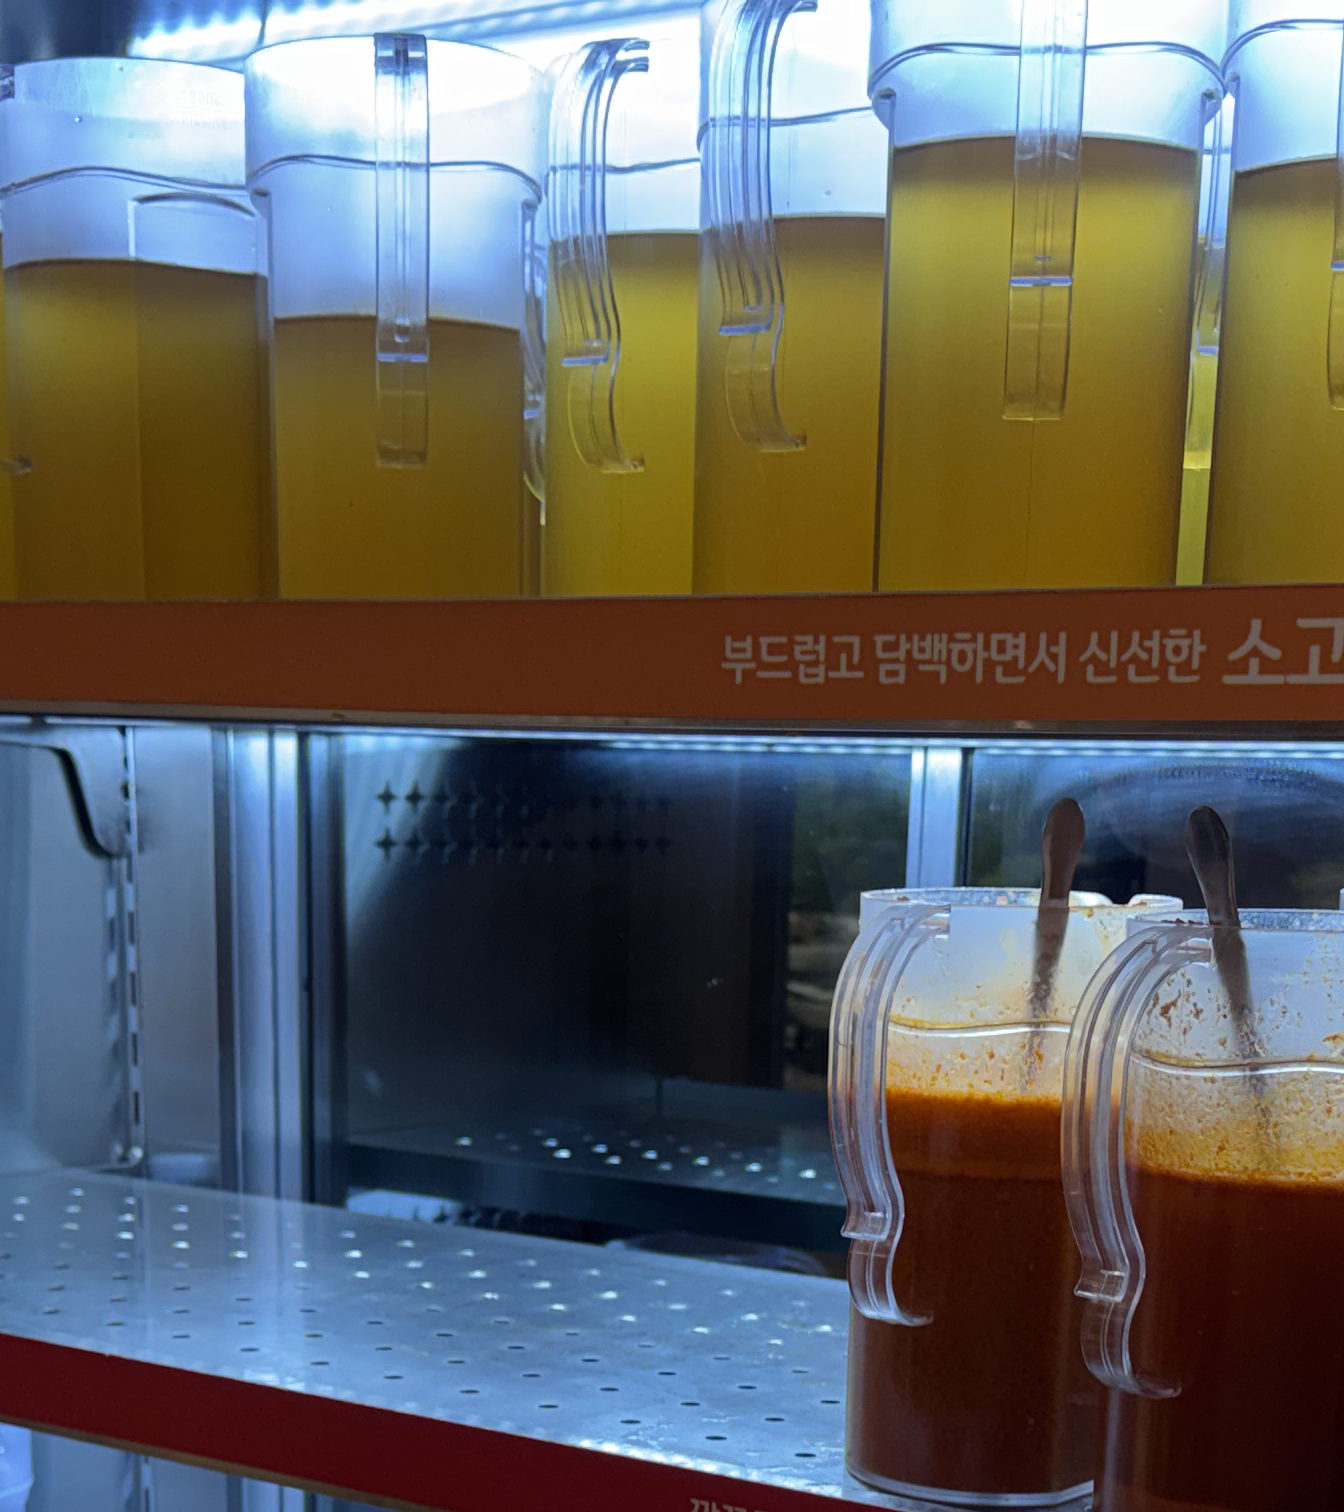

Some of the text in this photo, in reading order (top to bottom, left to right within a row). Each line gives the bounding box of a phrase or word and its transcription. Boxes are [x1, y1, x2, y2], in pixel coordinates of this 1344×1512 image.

[721, 635, 865, 685] 부드럽고
[874, 631, 1067, 684] 담백하면서
[1079, 628, 1207, 684] 신선한
